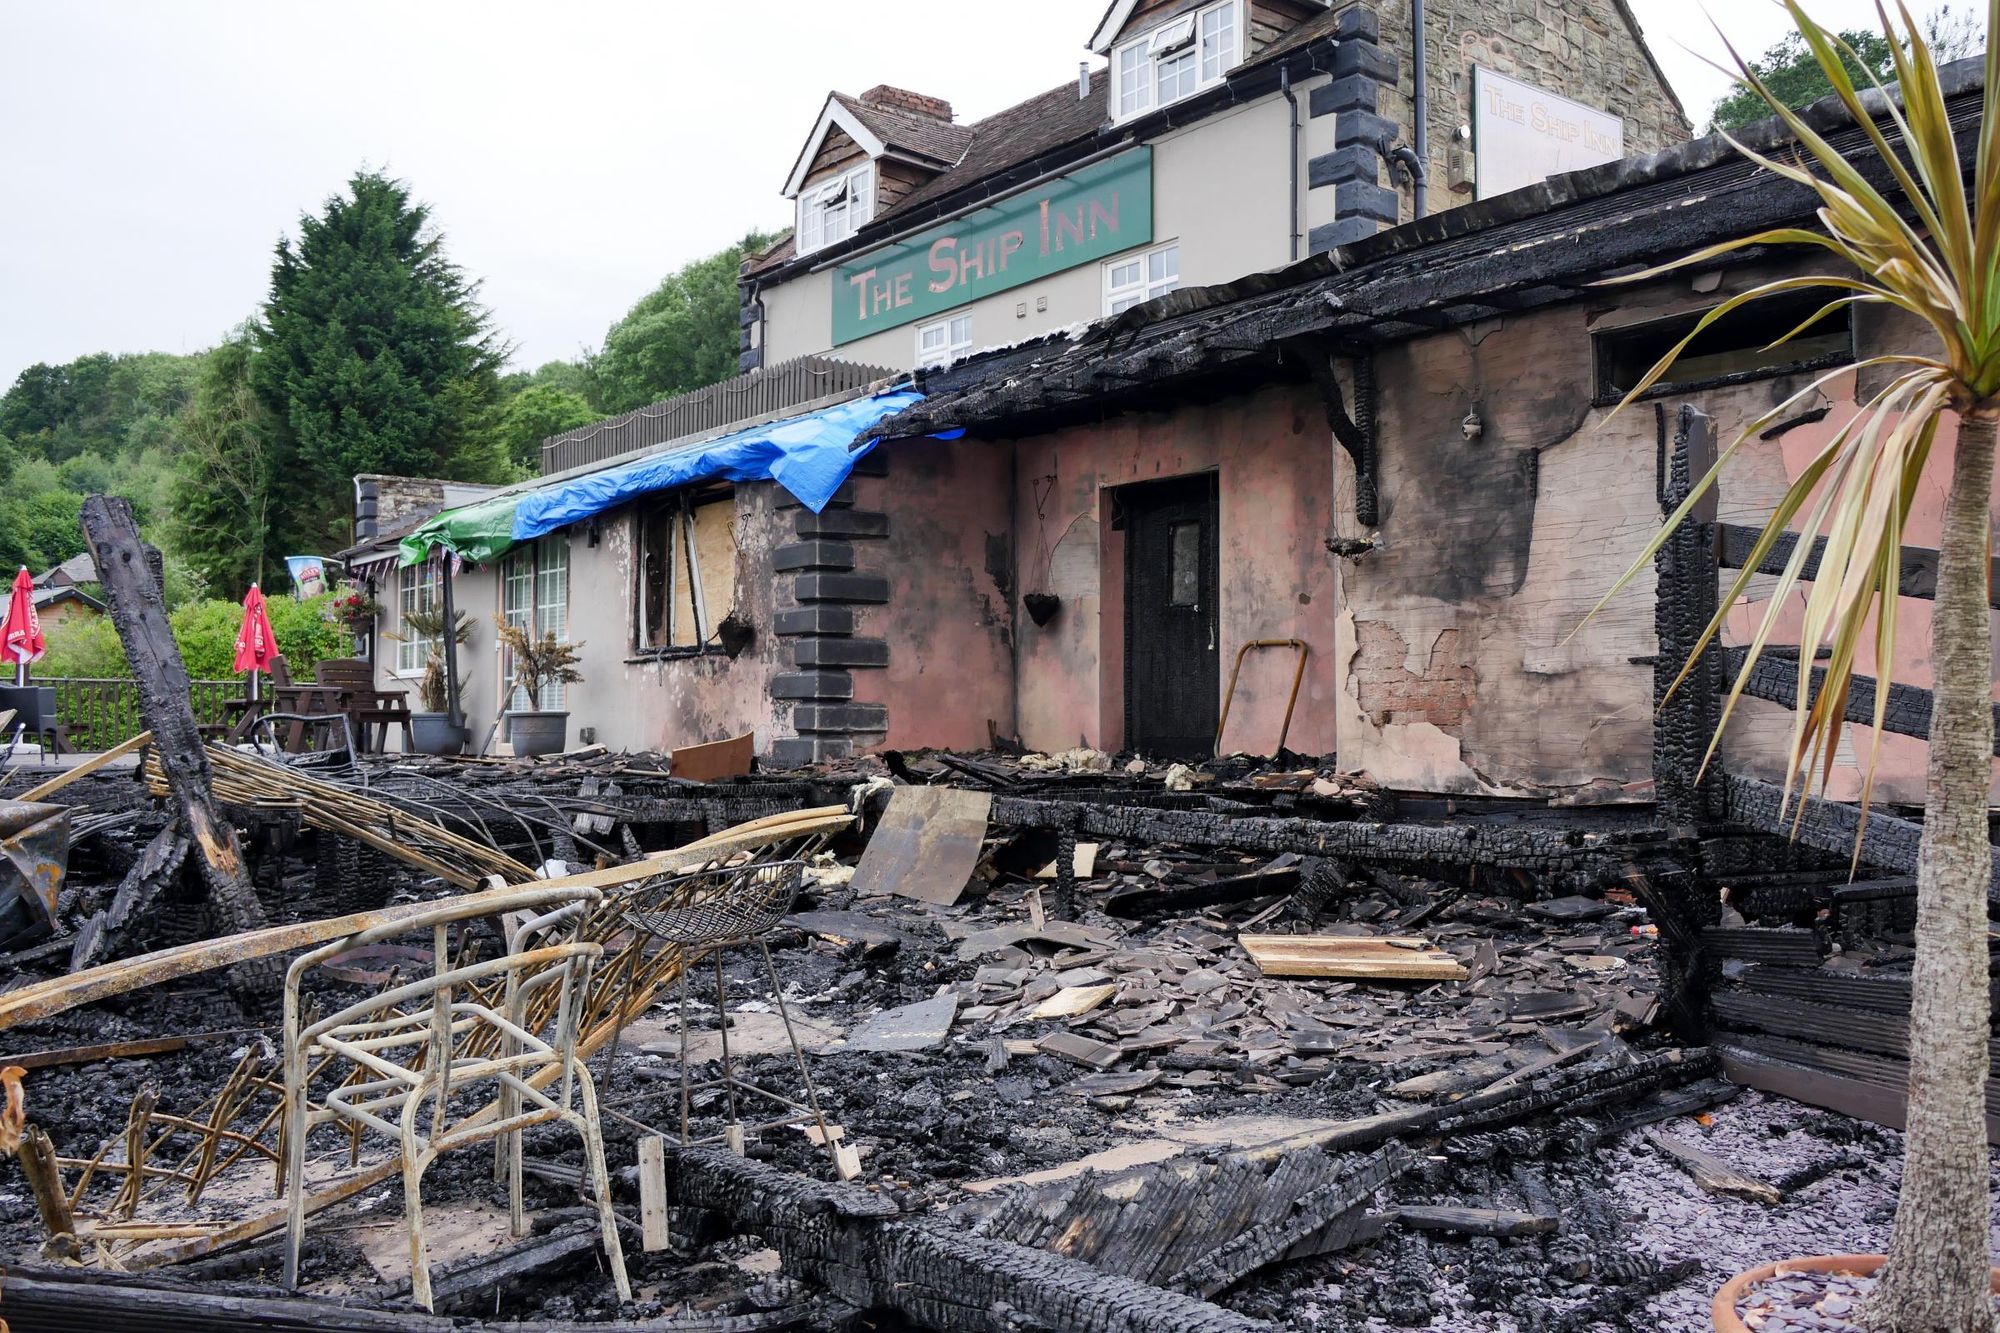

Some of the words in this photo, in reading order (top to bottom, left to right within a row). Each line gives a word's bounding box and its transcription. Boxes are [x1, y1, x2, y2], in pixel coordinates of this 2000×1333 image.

[1486, 84, 1525, 125] THE
[1530, 102, 1580, 143] SHIP
[1583, 120, 1617, 156] INN
[850, 268, 912, 320] THE
[928, 230, 1022, 293] SHIP
[1039, 192, 1118, 256] INN
